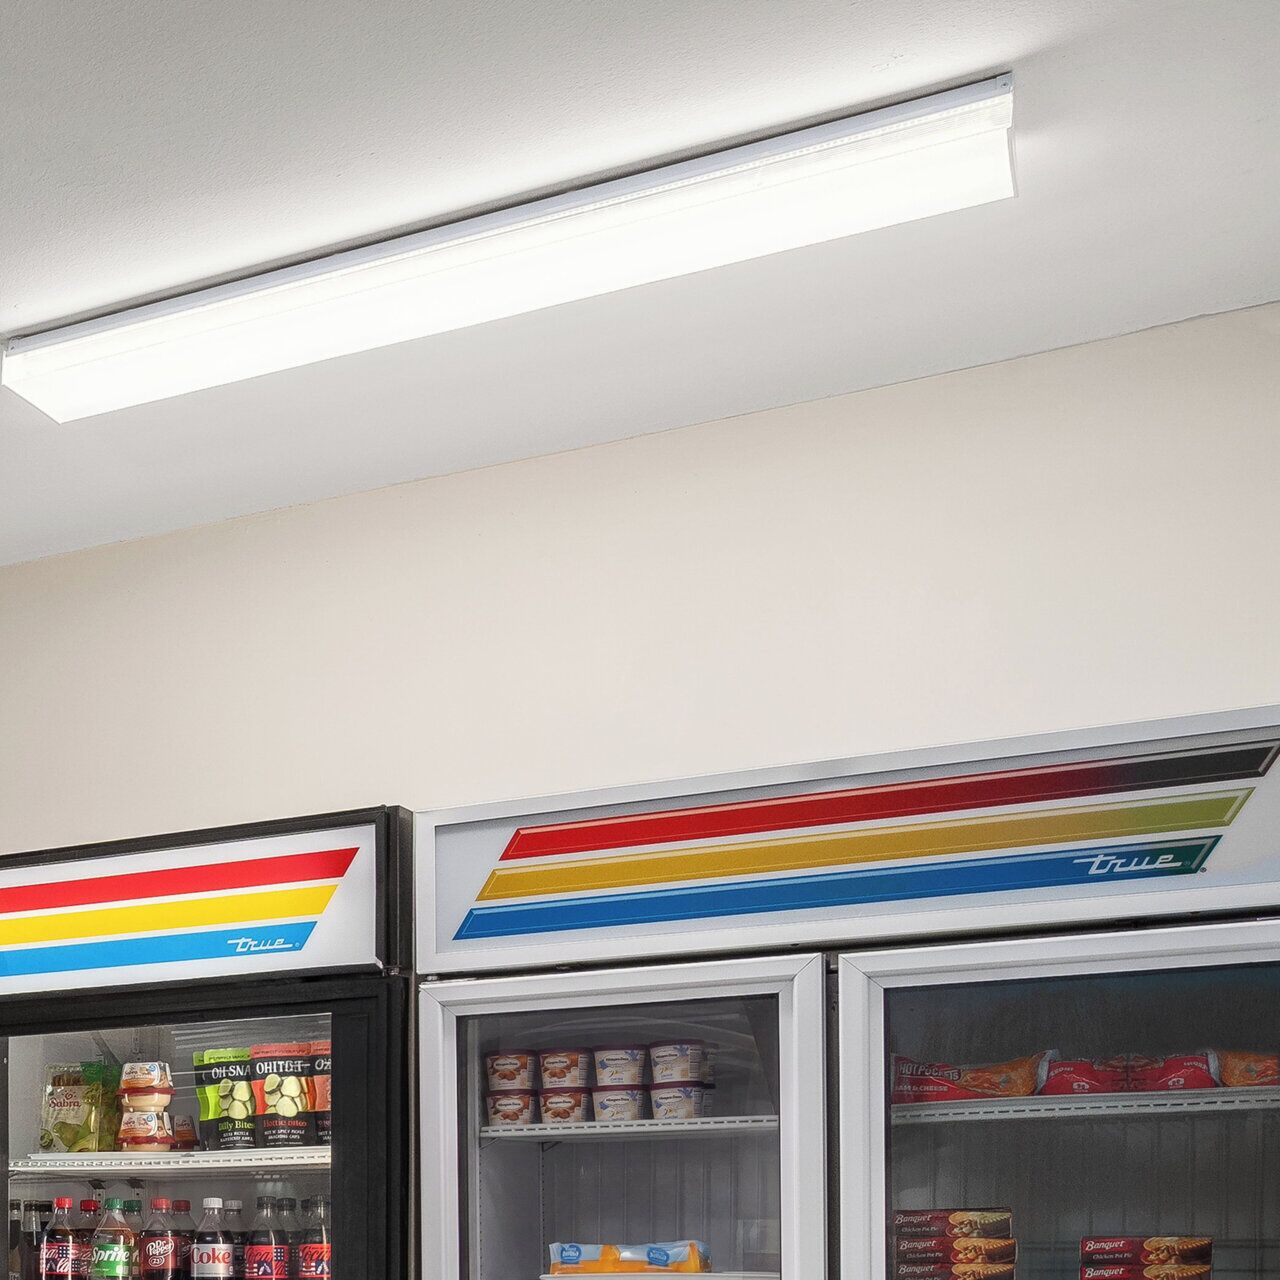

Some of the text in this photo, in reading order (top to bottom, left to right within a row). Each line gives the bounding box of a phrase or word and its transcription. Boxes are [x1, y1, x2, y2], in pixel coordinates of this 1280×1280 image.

[48, 1096, 82, 1109] Sabra
[91, 1245, 130, 1263] Sprite
[191, 1247, 231, 1265] Coke
